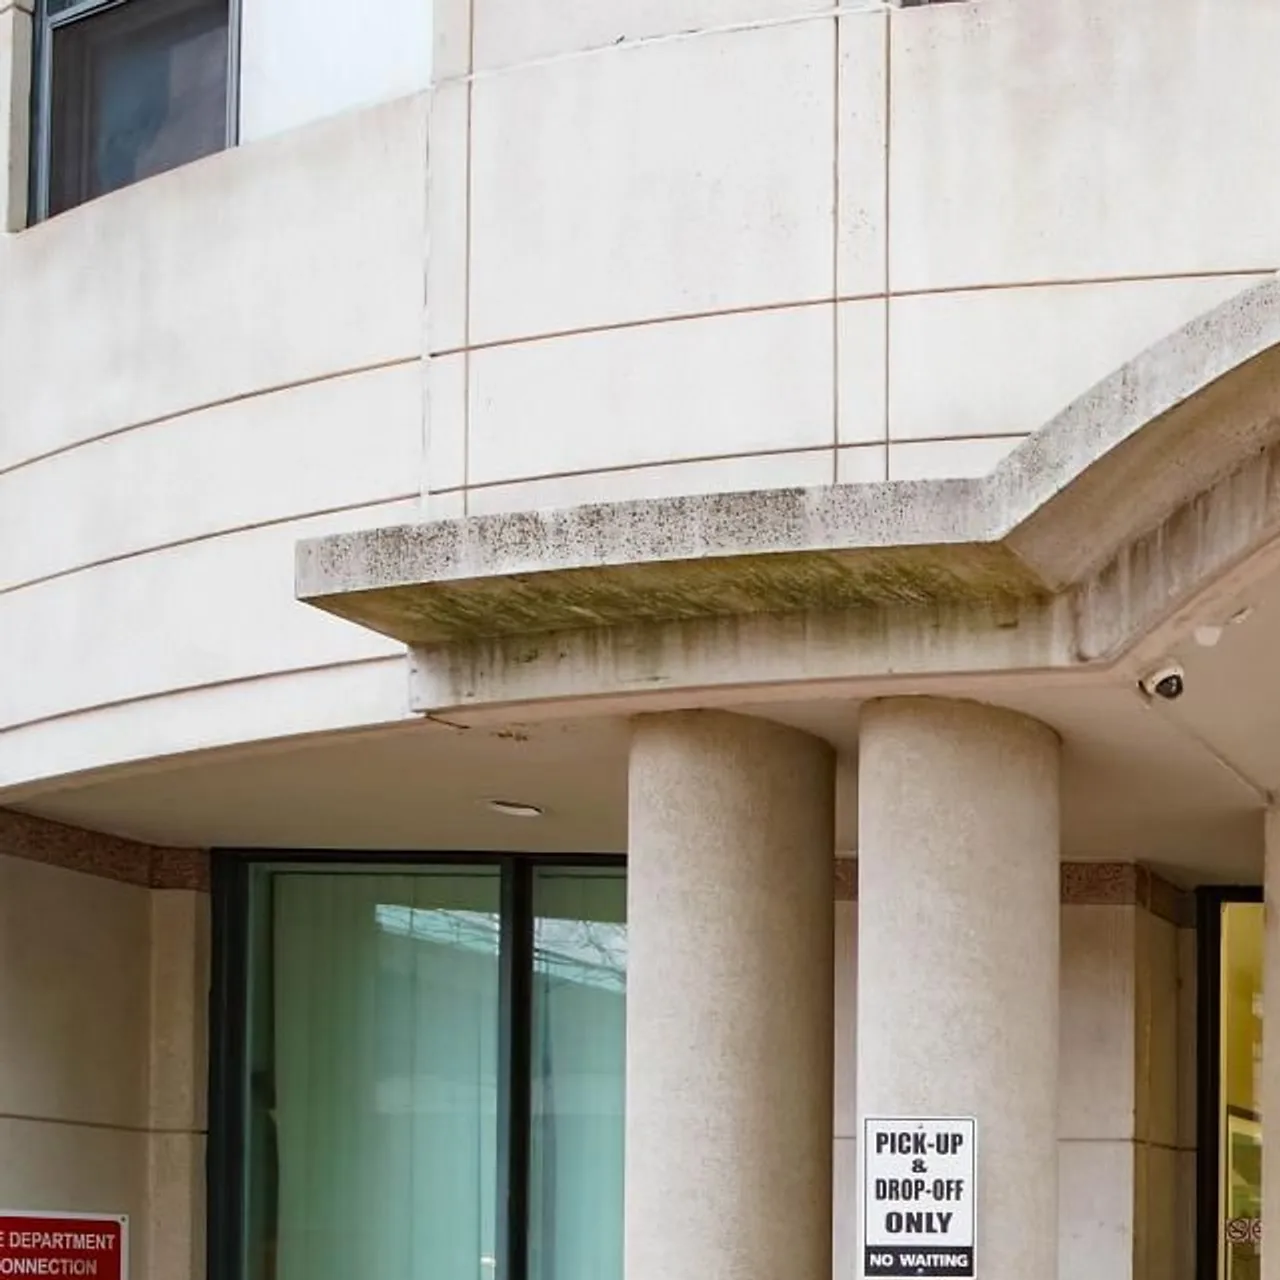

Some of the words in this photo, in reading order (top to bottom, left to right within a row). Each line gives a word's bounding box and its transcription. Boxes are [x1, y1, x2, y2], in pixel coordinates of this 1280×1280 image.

[875, 1132, 963, 1155] PICK-UP
[911, 1158, 928, 1173] &
[875, 1178, 964, 1201] DROP-OFF
[885, 1211, 953, 1233] ONLY
[9, 1231, 115, 1249] DEPARTMENT
[0, 1258, 97, 1276] ONNECTION
[869, 1254, 893, 1267] NO
[900, 1254, 968, 1267] WAITING
